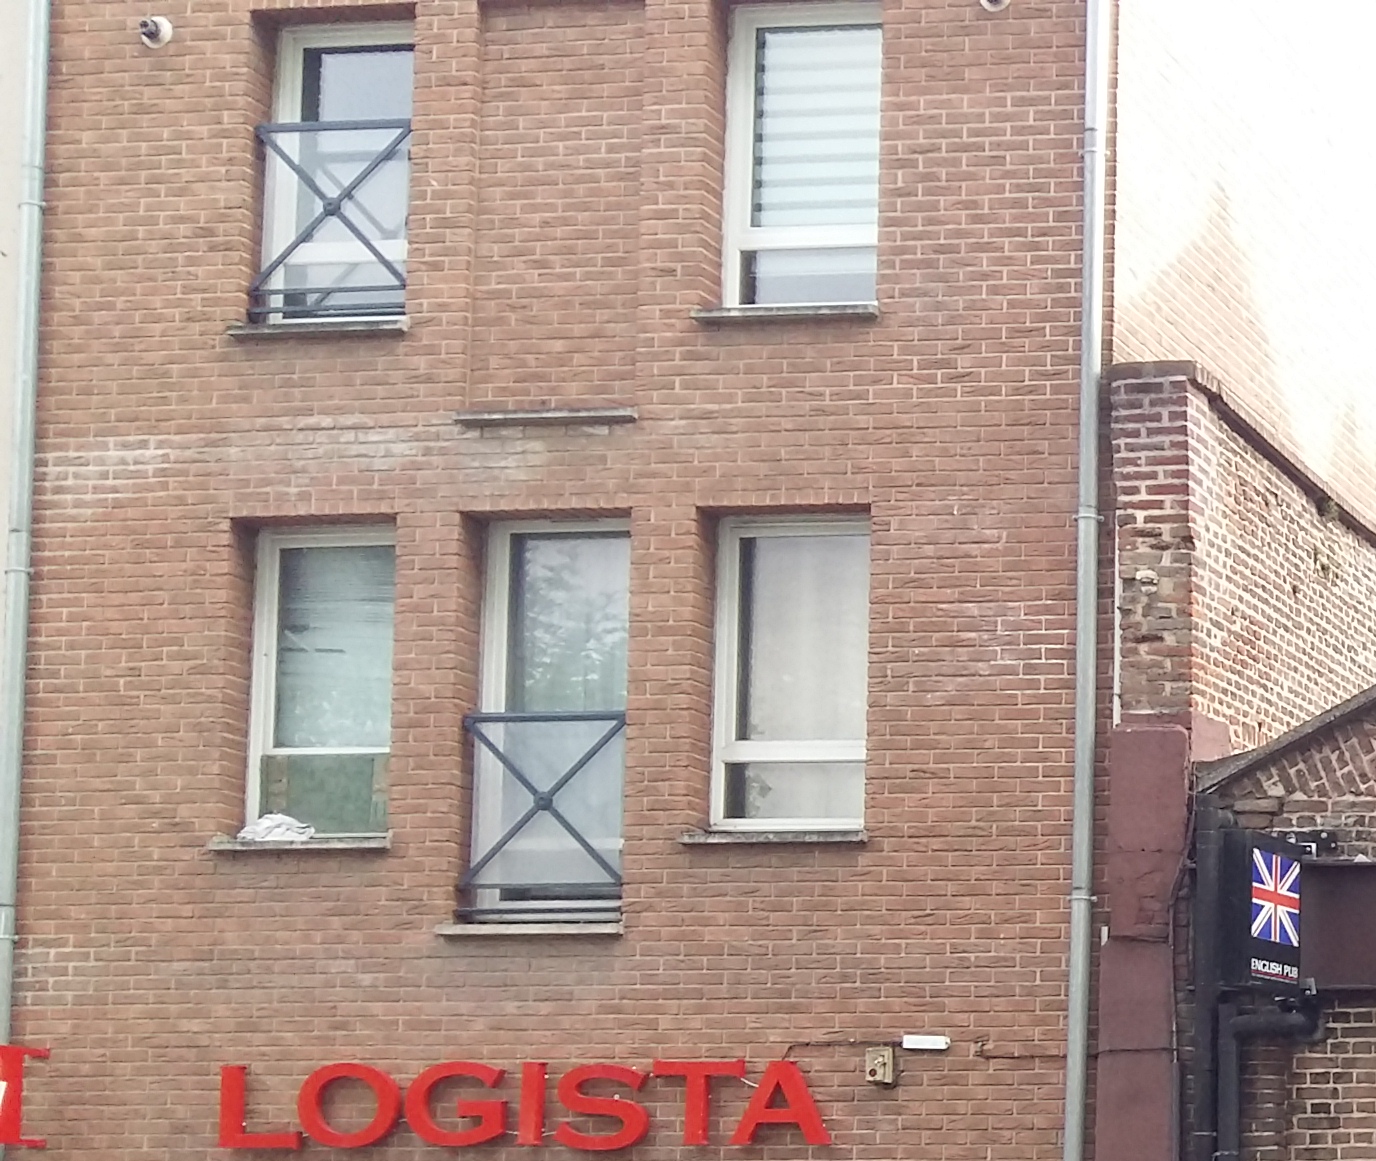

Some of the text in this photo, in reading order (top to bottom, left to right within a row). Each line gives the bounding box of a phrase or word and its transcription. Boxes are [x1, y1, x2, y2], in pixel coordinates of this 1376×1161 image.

[1251, 957, 1299, 978] ENGLISH PUB
[217, 1058, 834, 1152] LOGISTA
